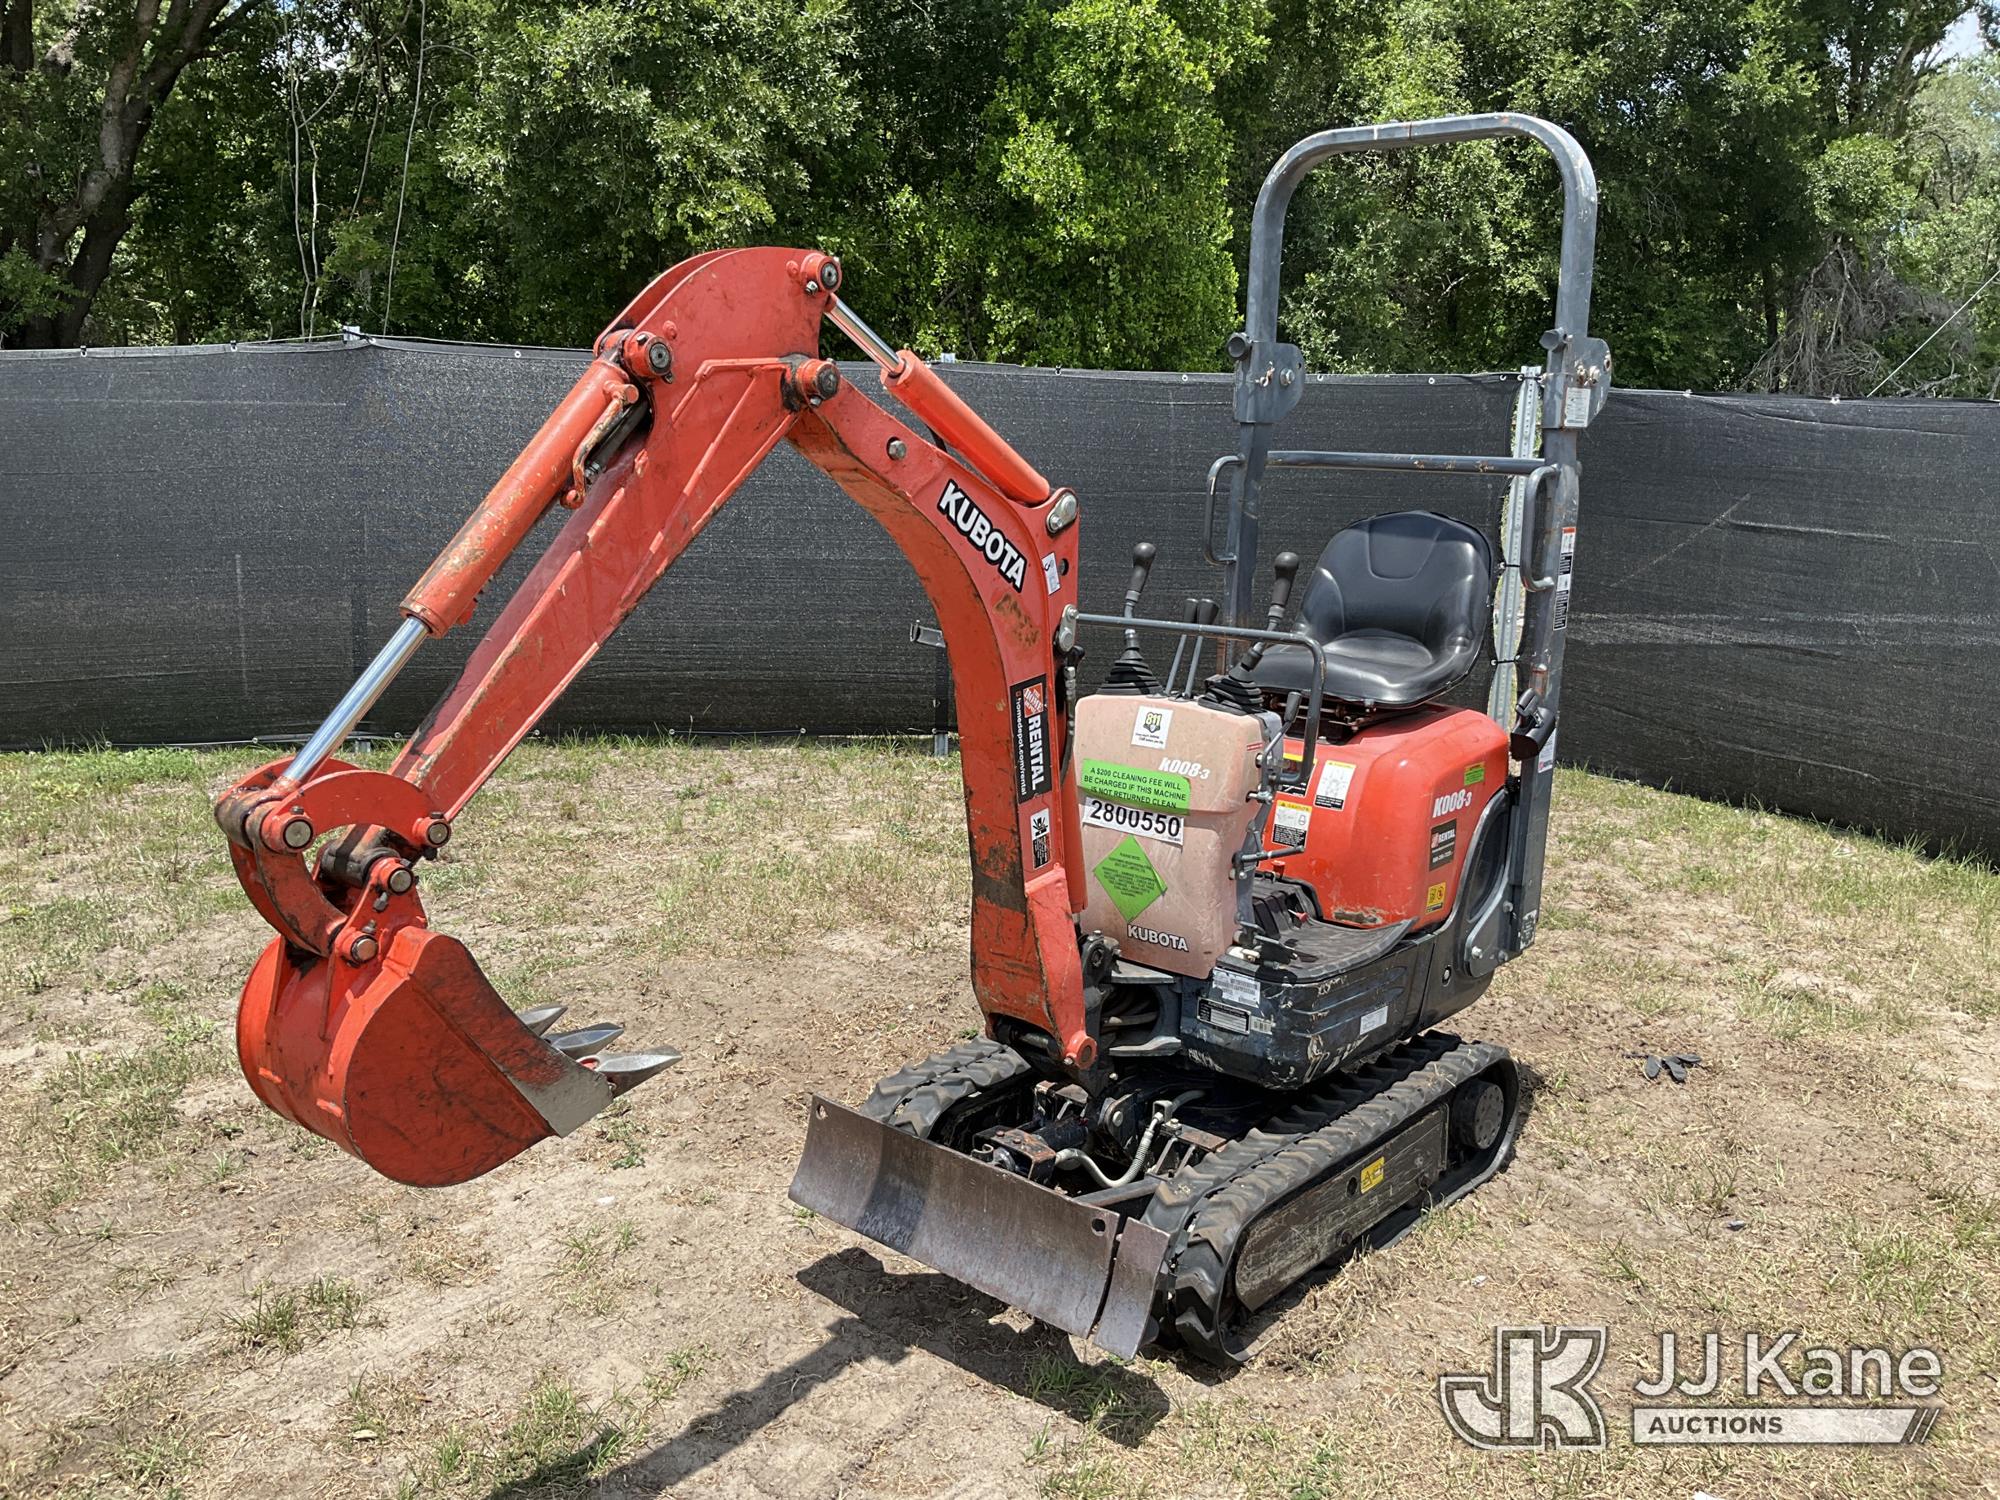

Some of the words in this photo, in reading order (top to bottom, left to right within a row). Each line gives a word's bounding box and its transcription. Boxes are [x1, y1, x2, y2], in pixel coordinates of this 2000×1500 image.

[938, 480, 1027, 591] KUBOTA
[1145, 711, 1163, 726] 811
[1016, 697, 1027, 795] homedepot.com/rental
[1028, 714, 1045, 790] RENTAL
[1084, 775, 1092, 783] BE
[1094, 777, 1128, 790] CHARGED
[1128, 783, 1135, 791] IF
[1137, 785, 1152, 794] THIS
[1153, 788, 1187, 802] MACHINE
[1090, 767, 1096, 775] A
[1096, 768, 1111, 777] $200
[1112, 770, 1147, 784] CLEANING
[1149, 777, 1163, 787] FEE
[1164, 780, 1181, 791] WILL
[1098, 787, 1112, 796] NOT
[1114, 790, 1151, 804] RETURNED
[1152, 798, 1177, 809] CLEAN
[1432, 789, 1472, 818] K008-3
[1090, 799, 1181, 837] 2800550
[1127, 924, 1189, 952] KUBOTA
